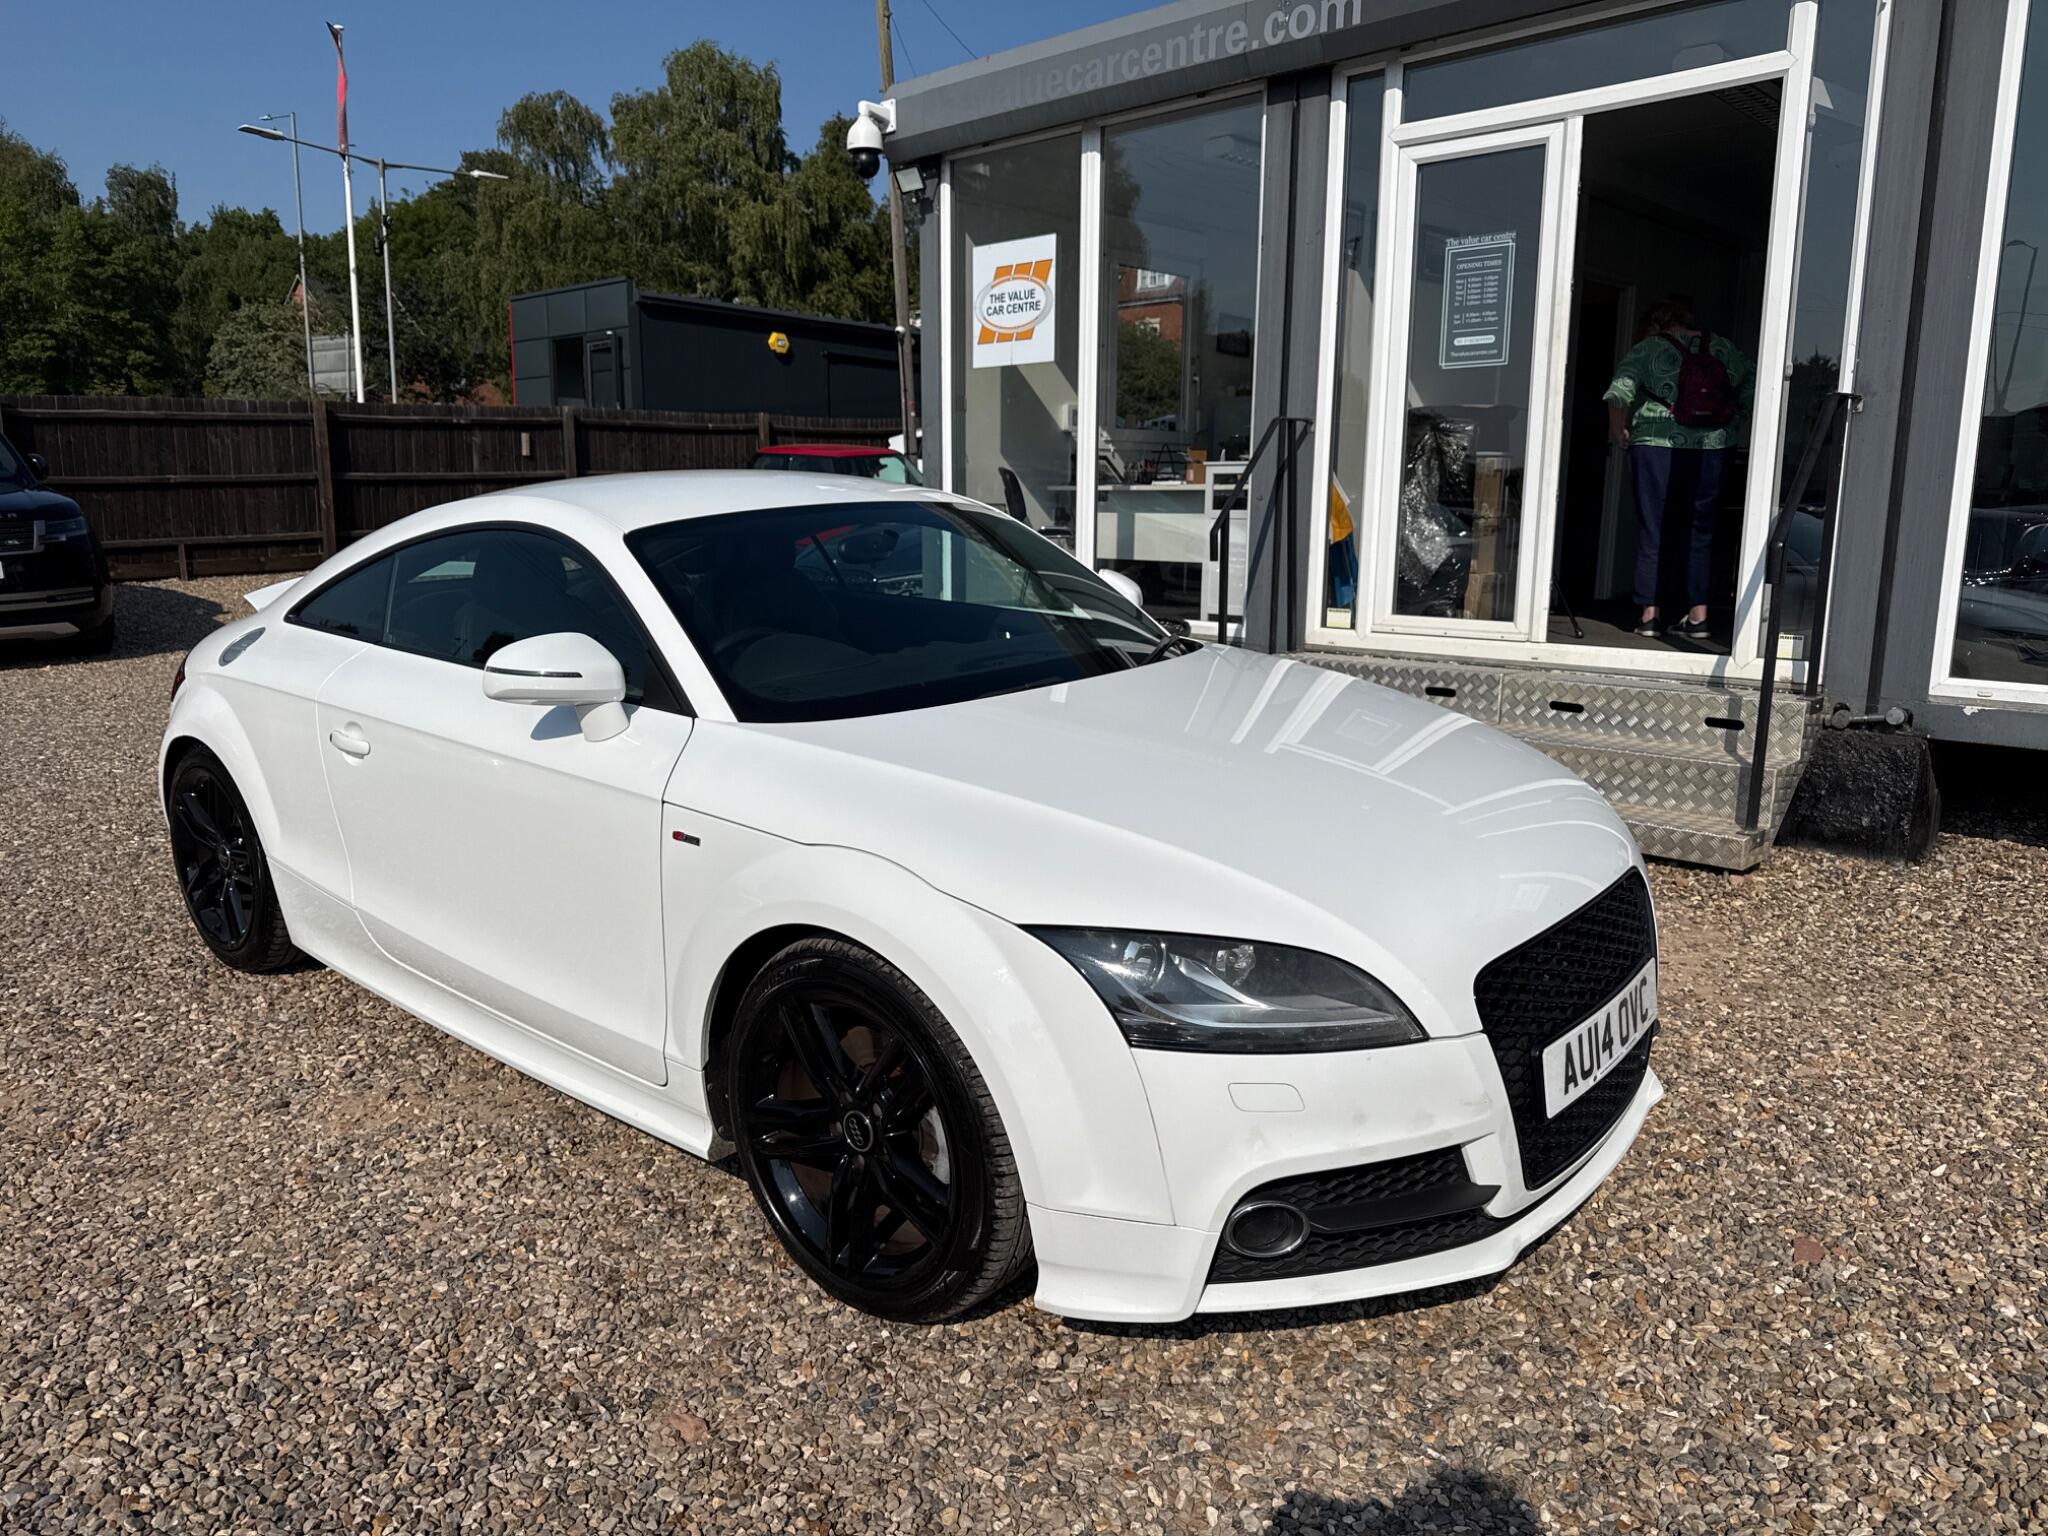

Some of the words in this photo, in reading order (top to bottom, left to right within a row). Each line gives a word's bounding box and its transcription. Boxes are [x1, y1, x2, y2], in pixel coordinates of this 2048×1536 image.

[989, 292, 1006, 304] THE
[1008, 288, 1036, 301] VALUE
[986, 306, 1005, 317] CAR
[1006, 301, 1041, 314] CENTRE
[1563, 1011, 1614, 1095] AU14
[1618, 975, 1650, 1047] OVC
